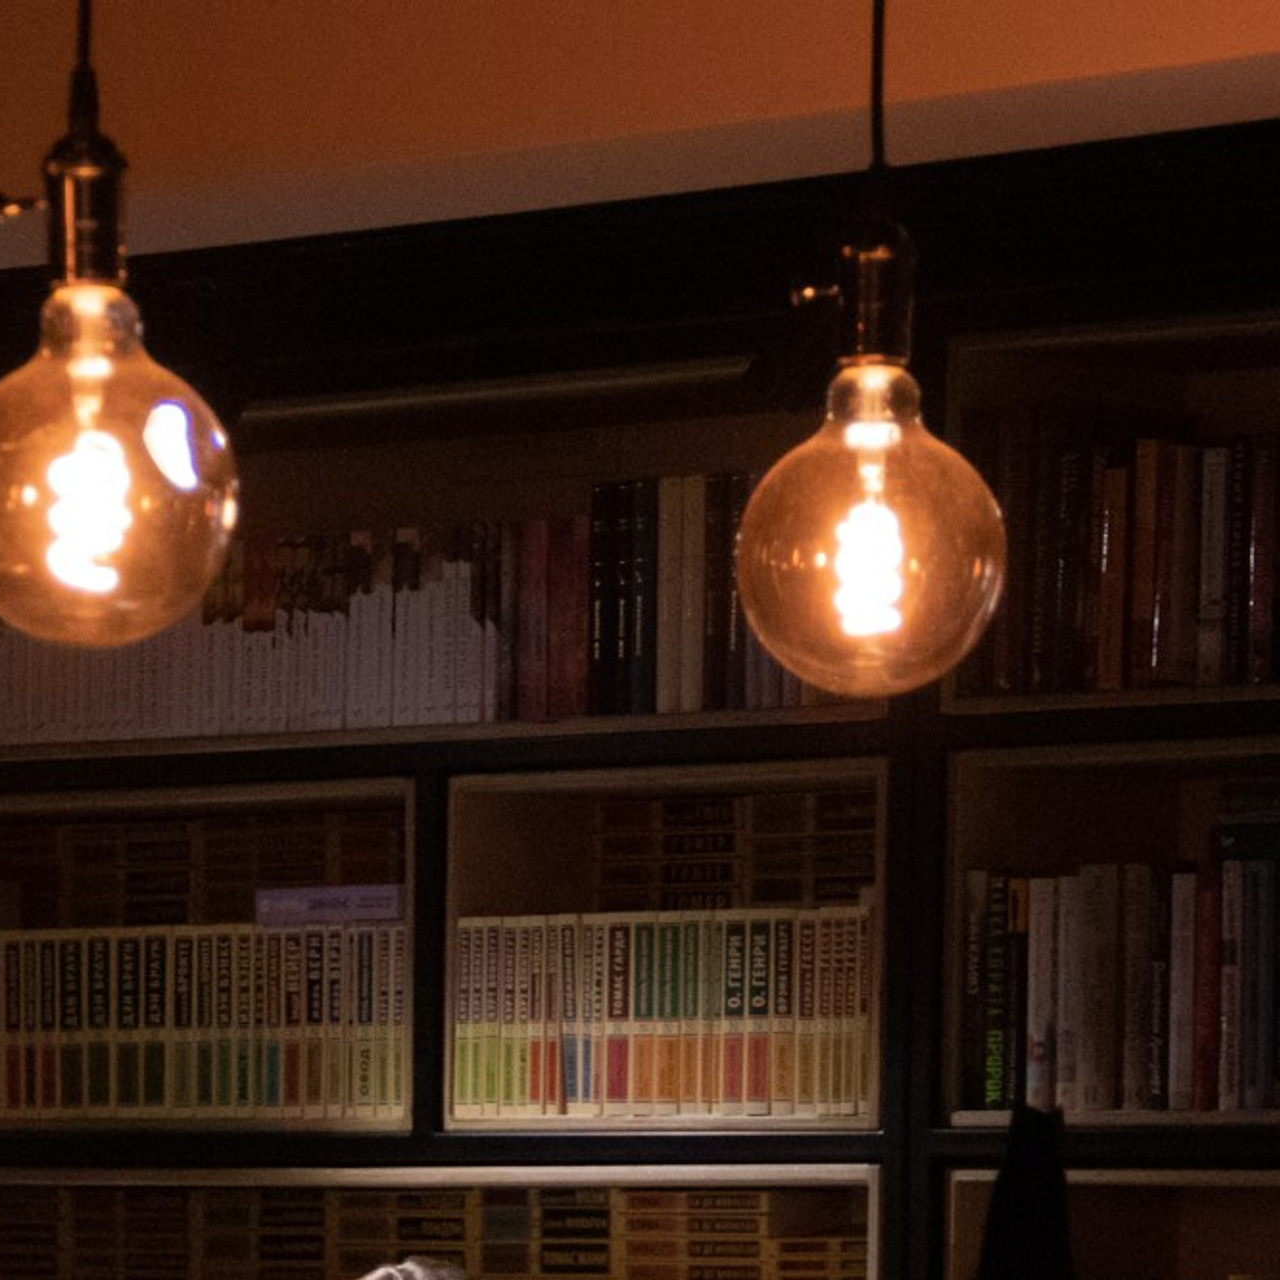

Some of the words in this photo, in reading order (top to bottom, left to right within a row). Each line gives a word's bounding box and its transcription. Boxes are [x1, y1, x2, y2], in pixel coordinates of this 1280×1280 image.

[94, 941, 105, 989] БРАУН
[123, 942, 135, 990] БРАУН
[150, 939, 161, 988] БРАУН
[308, 936, 321, 981] ВЕРН
[612, 929, 625, 972] ГАРДИ
[727, 935, 742, 987] ГЕНРИ
[750, 934, 765, 987] ГЕНРИ
[612, 973, 625, 1016] ТОМАС
[727, 992, 743, 1008] О.
[750, 991, 766, 1008] О.
[359, 1048, 370, 1097] ОВОД
[985, 1029, 1004, 1105] ПРОРОК
